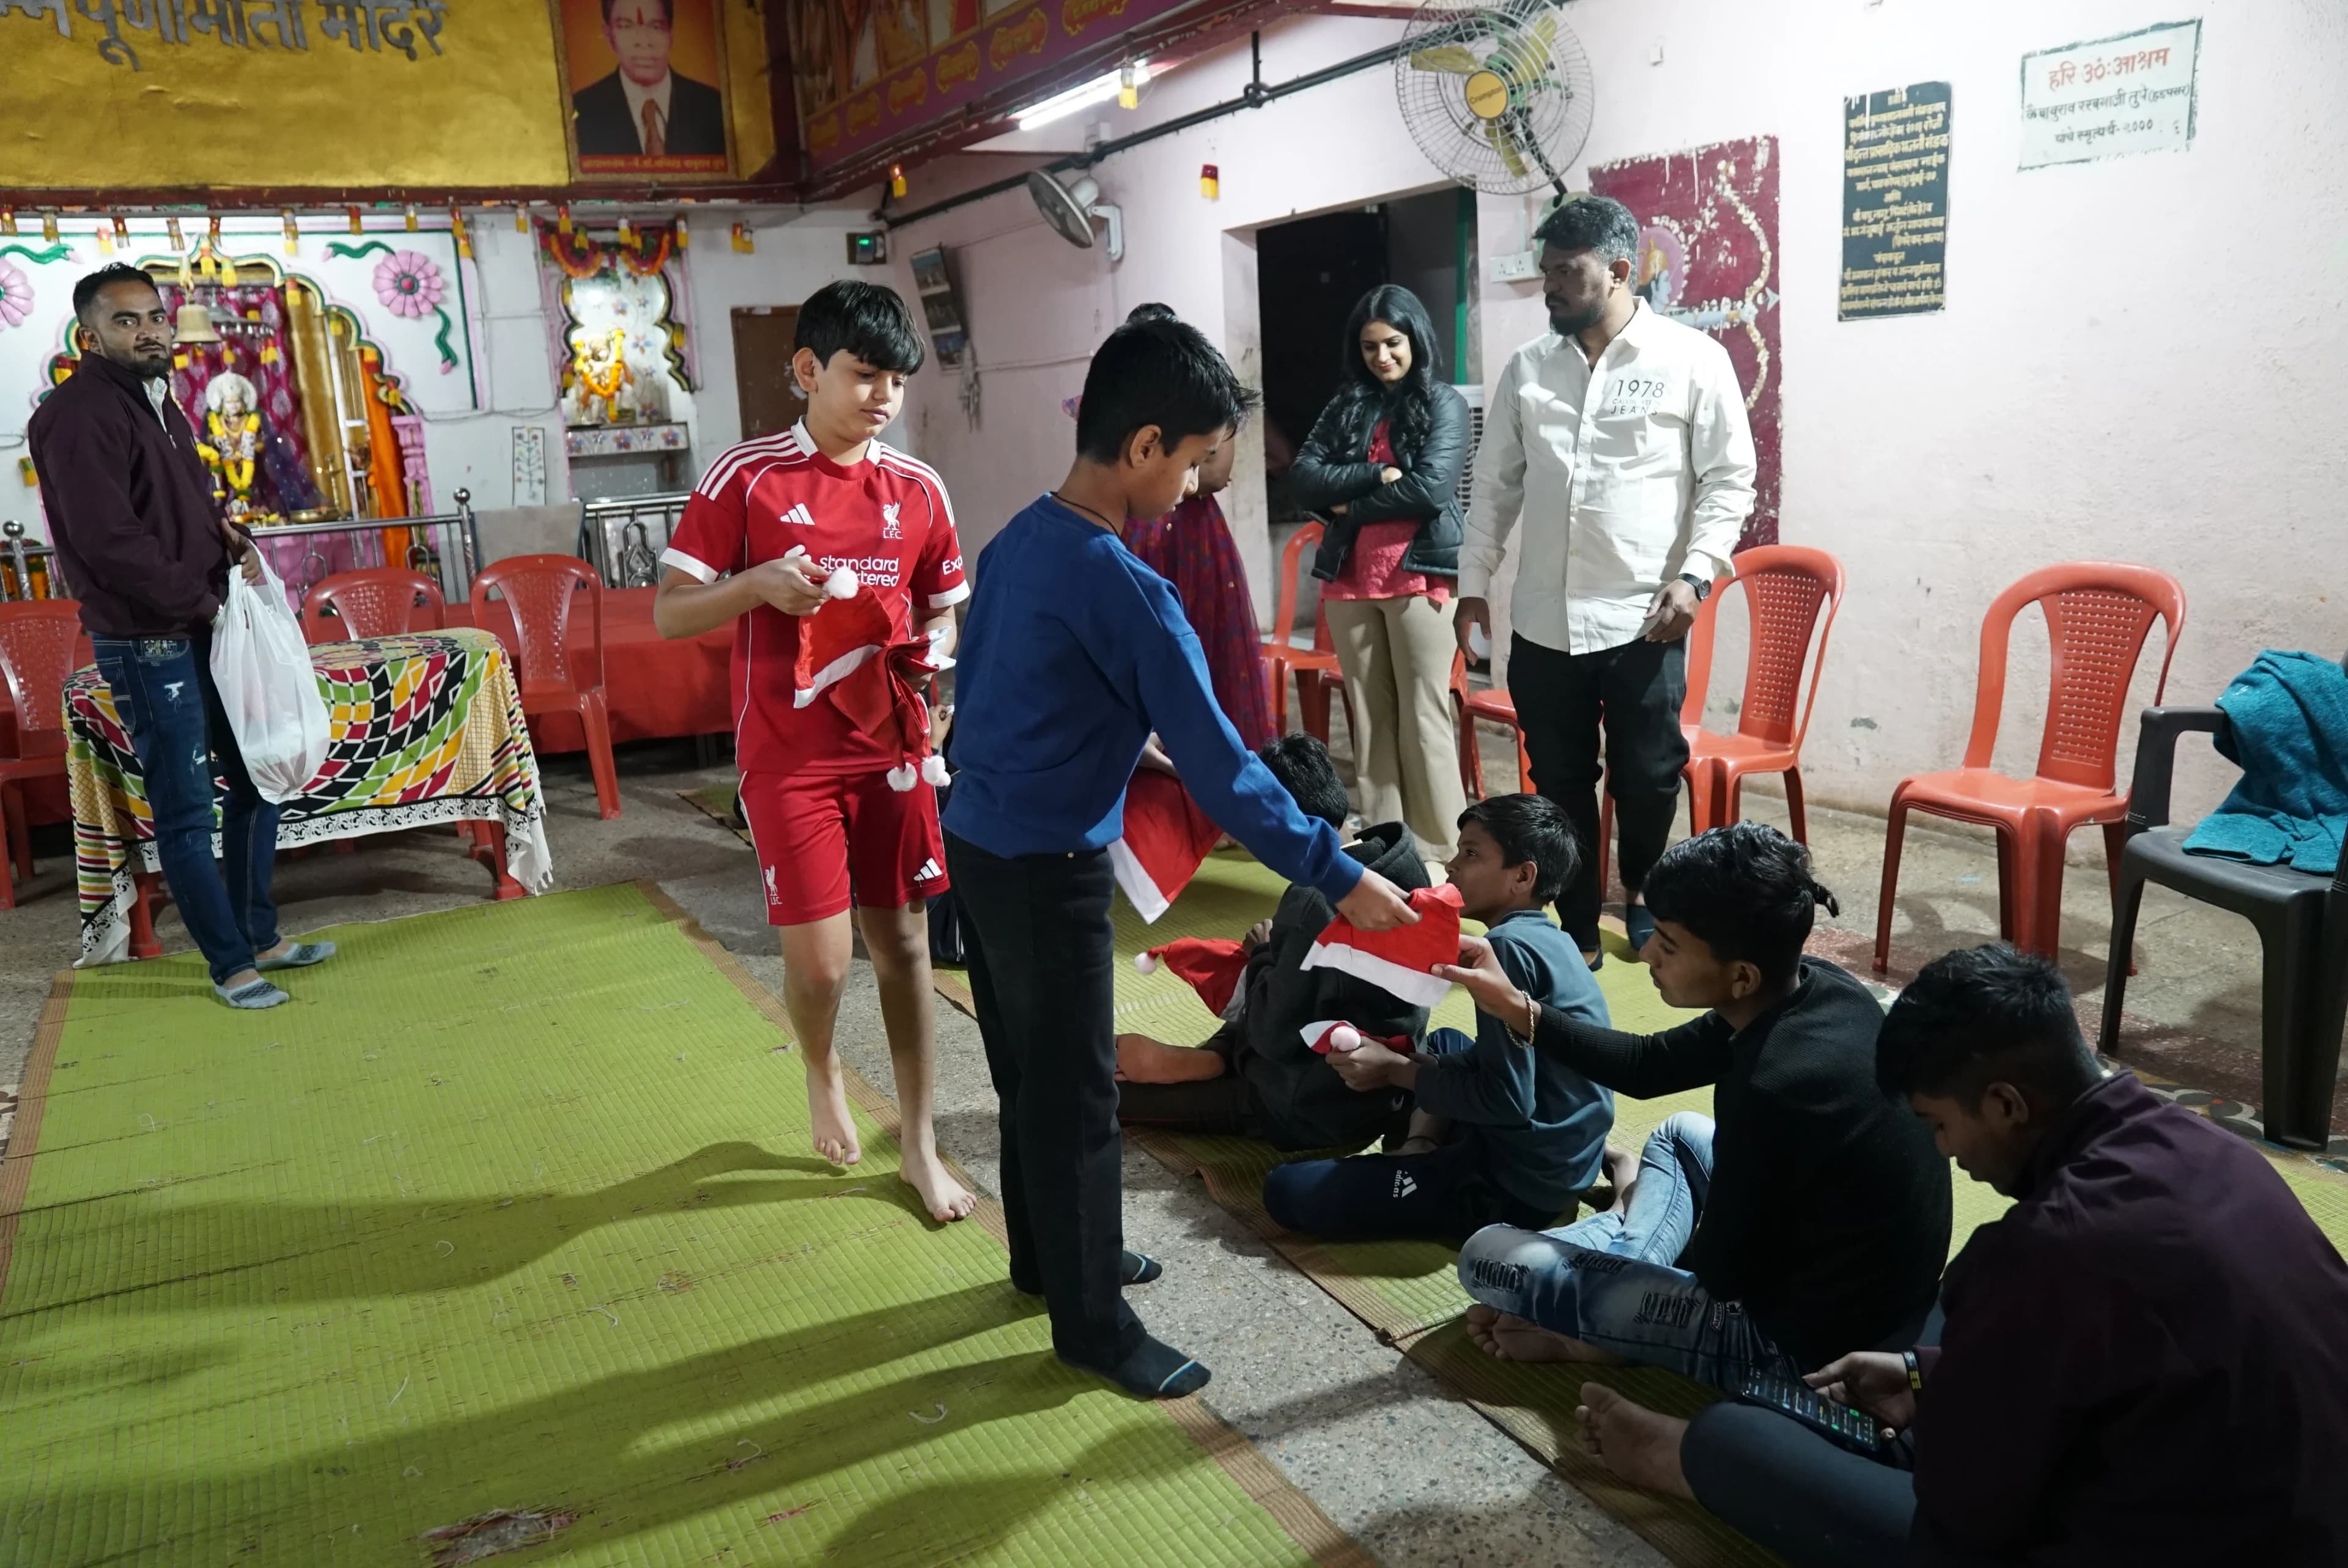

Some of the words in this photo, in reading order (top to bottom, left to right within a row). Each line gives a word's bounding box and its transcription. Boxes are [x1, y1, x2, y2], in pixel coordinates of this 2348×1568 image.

[2049, 61, 2075, 91] हरि
[1618, 379, 1664, 398] 1978
[1611, 405, 1658, 416] JEANS
[820, 554, 899, 572] standard
